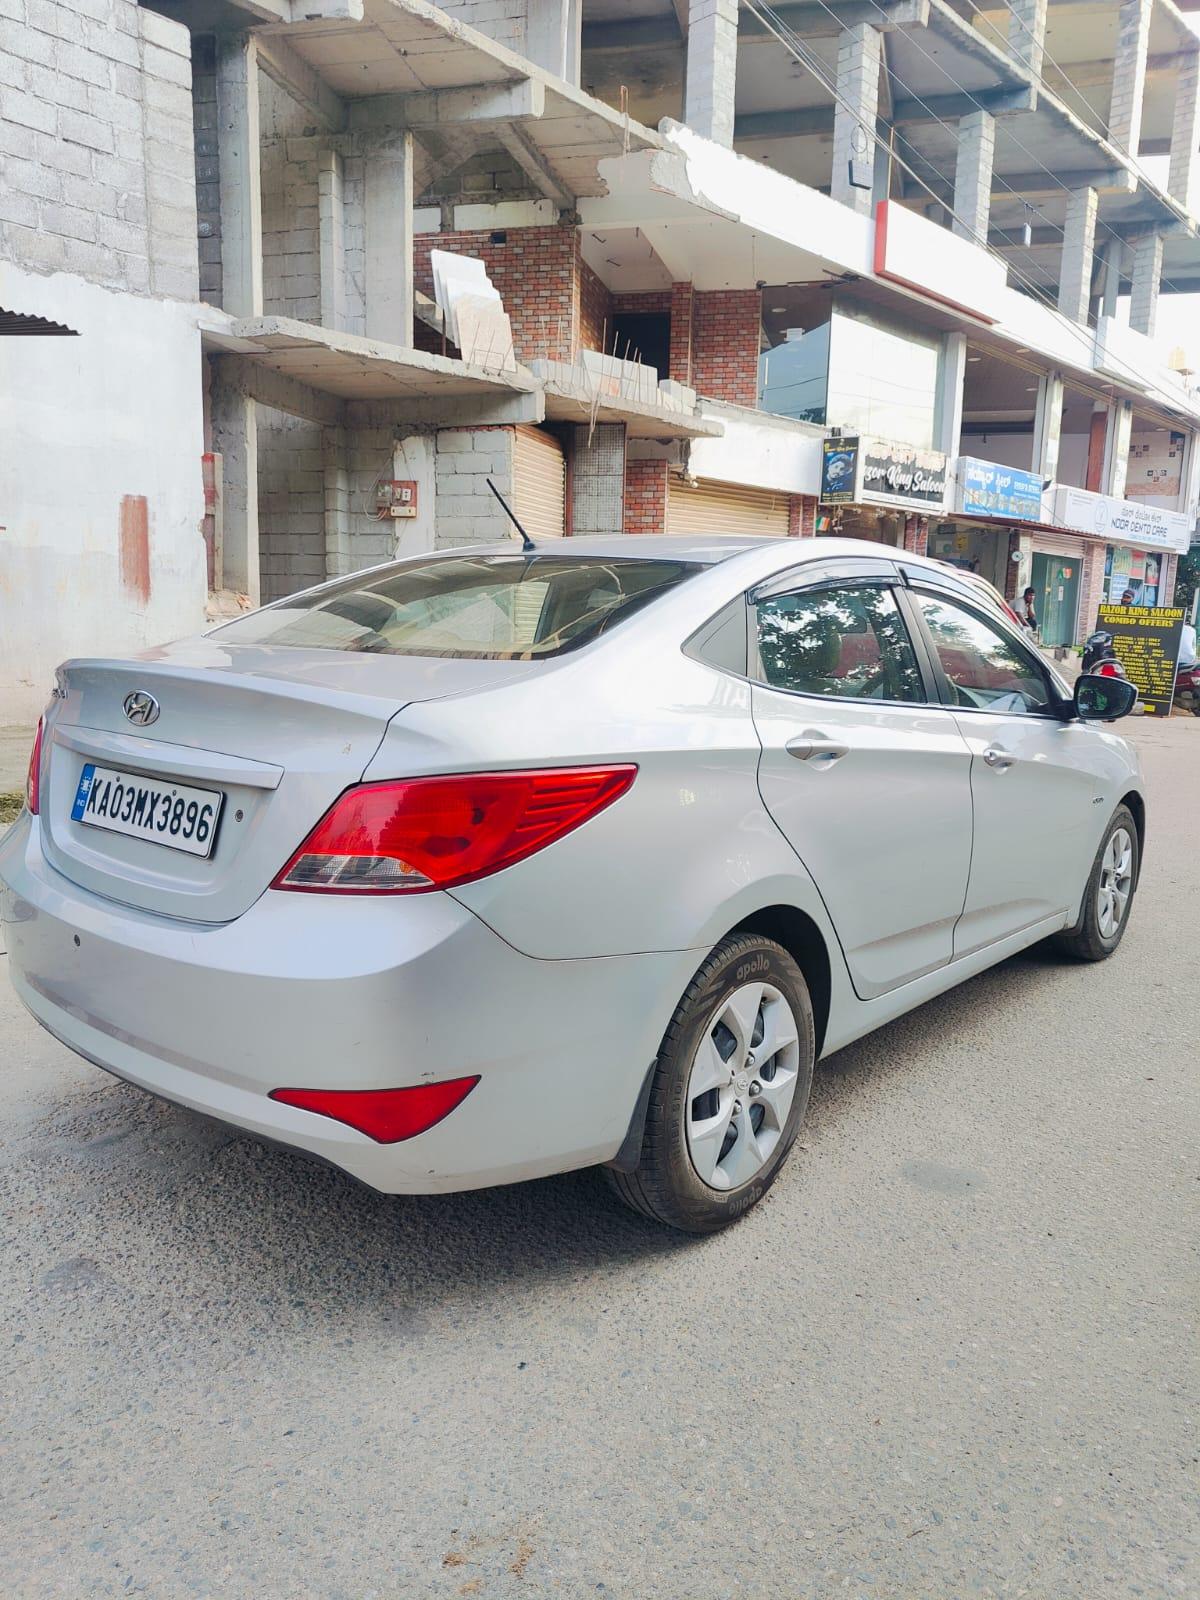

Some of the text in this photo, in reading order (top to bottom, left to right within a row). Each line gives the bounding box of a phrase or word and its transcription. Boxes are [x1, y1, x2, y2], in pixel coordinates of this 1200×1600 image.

[887, 465, 912, 489] King
[1111, 519, 1168, 538] NOOR DENTO CARE
[1100, 604, 1183, 618] RAZOR KING SALOON
[1104, 616, 1174, 628] COMBO OFFERS
[87, 778, 213, 842] KA03MX3896
[736, 953, 770, 981] apollo
[728, 1185, 763, 1217] apollo
